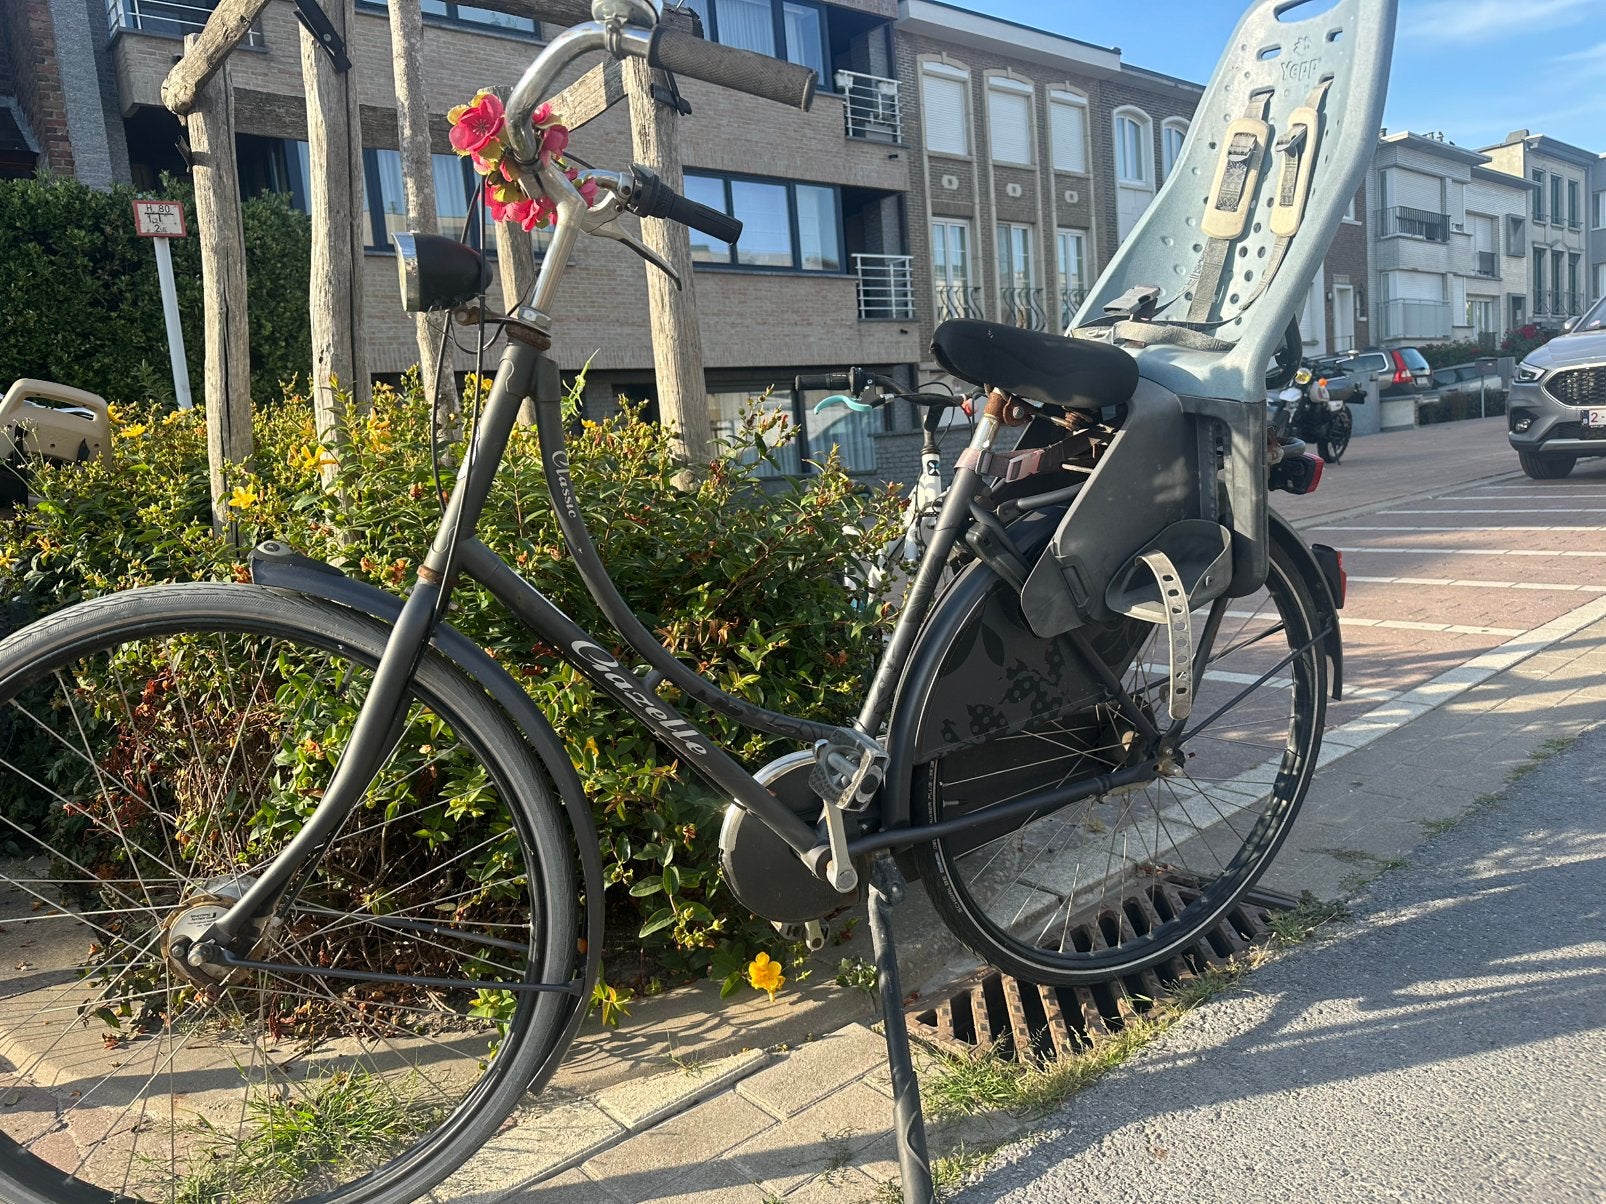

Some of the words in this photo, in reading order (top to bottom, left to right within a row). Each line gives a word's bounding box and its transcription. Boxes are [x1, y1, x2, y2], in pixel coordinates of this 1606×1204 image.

[158, 204, 171, 213] 80
[552, 450, 576, 519] Classic
[571, 640, 707, 755] Gazelle
